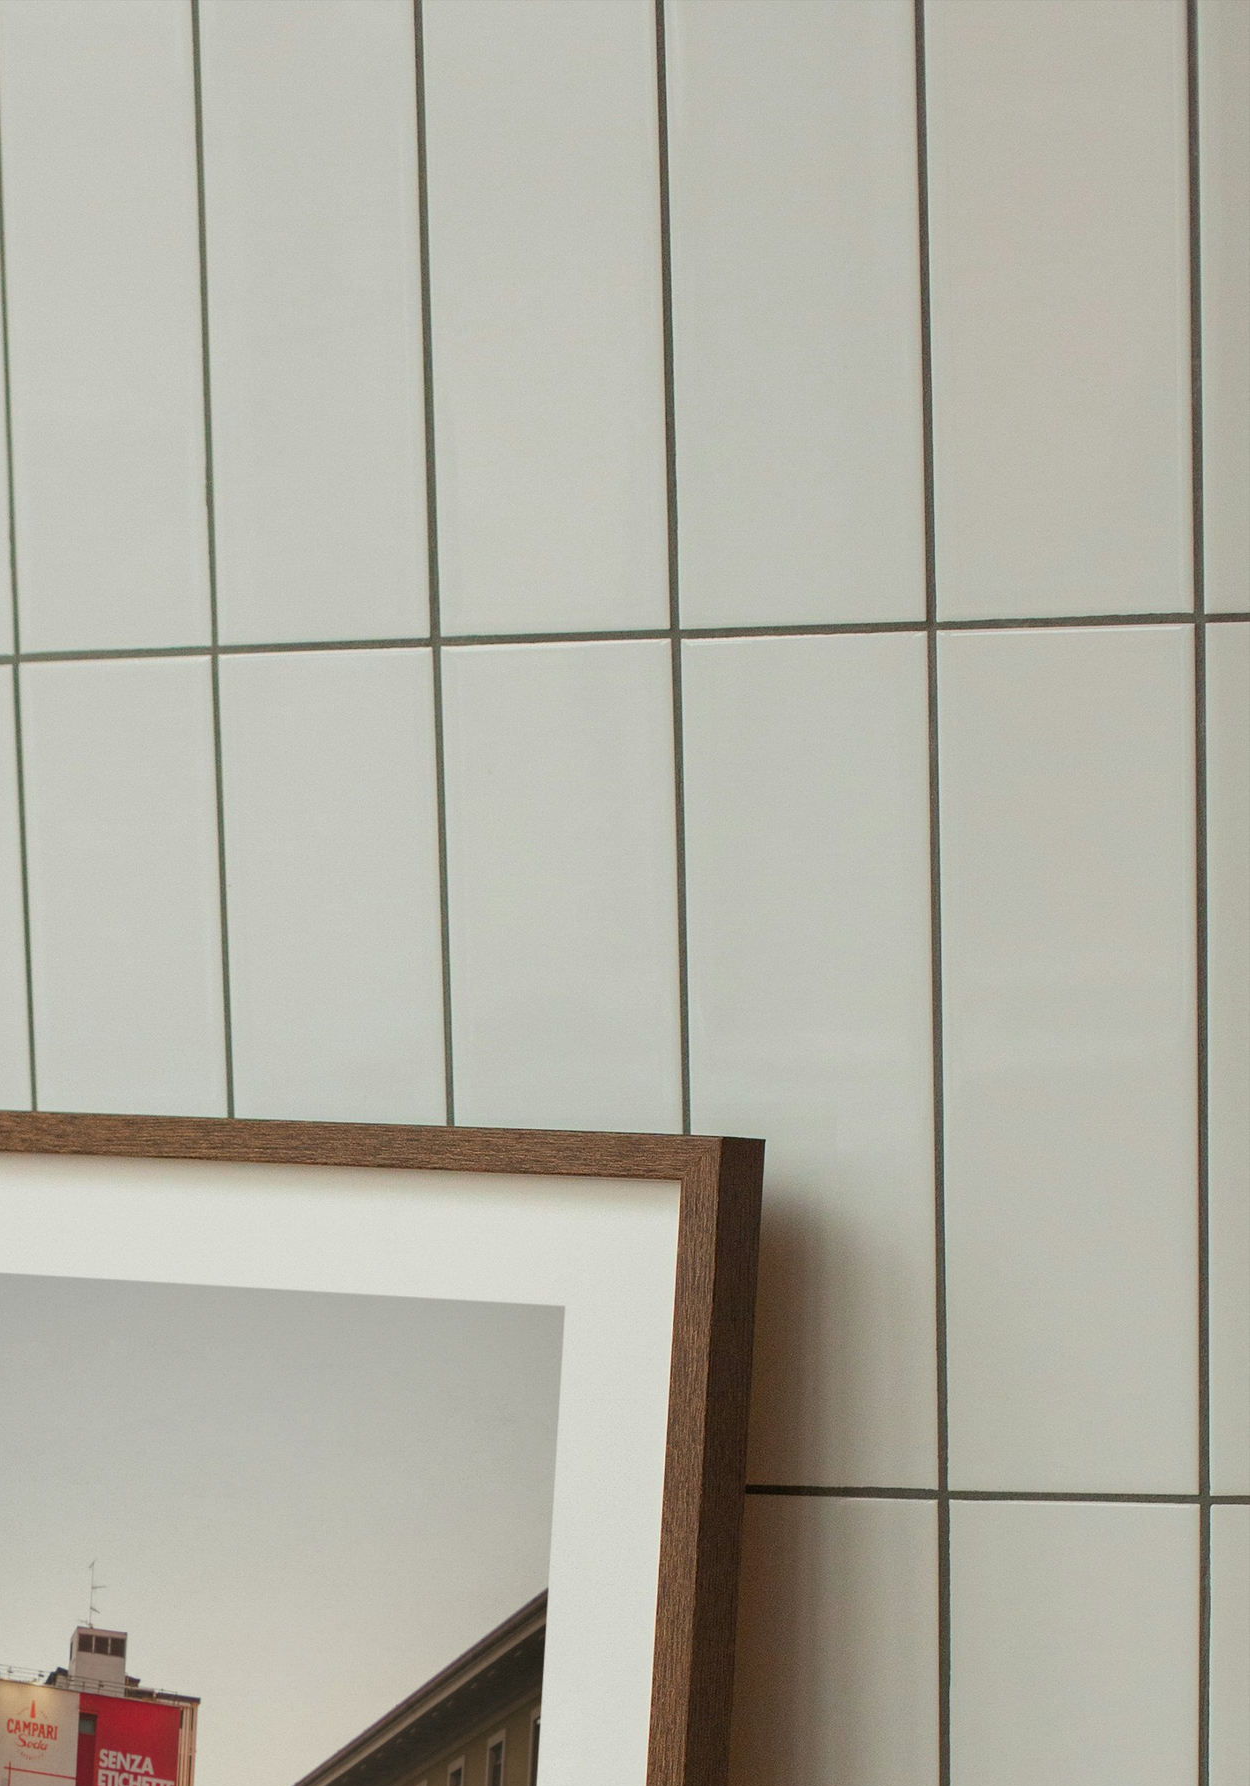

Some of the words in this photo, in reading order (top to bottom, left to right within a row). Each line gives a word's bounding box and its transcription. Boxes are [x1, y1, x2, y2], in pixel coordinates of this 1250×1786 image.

[6, 1718, 58, 1741] CAMPARI
[15, 1733, 48, 1751] Soda
[98, 1748, 154, 1775] SENZA
